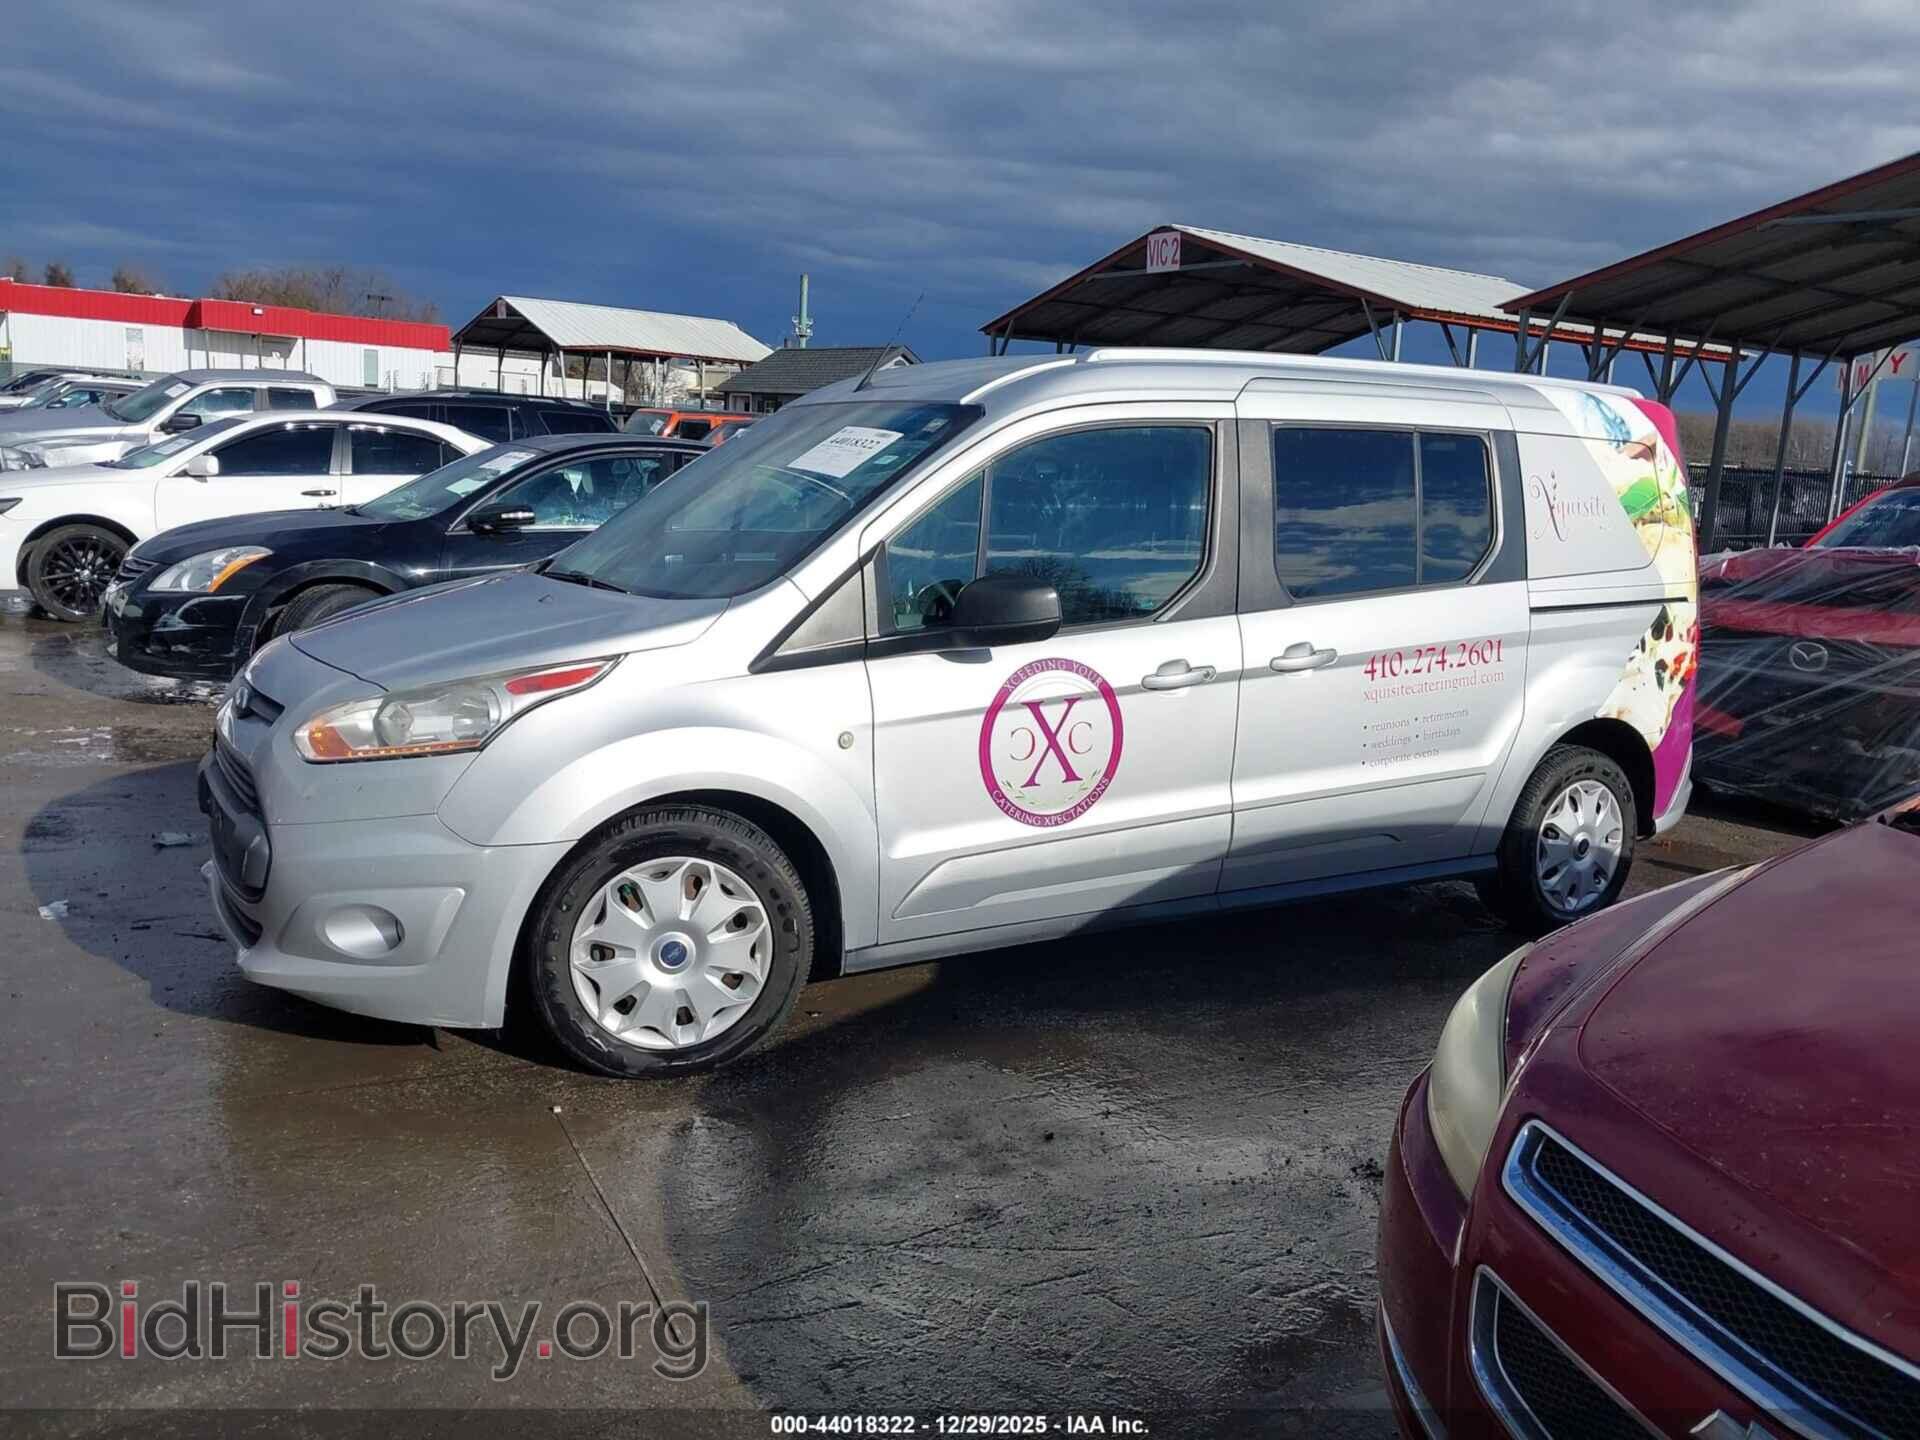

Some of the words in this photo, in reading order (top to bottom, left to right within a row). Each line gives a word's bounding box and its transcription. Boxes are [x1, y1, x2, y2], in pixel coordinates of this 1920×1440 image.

[1148, 237, 1169, 267] VIC
[1171, 237, 1179, 265] 2
[1888, 352, 1909, 374] Y
[1002, 658, 1068, 692] XCEEDING
[1072, 661, 1104, 688] YOUR
[1363, 639, 1504, 682] 410.274.2601
[1363, 670, 1505, 703] xquisitecateringmd.com
[1369, 752, 1412, 768] corporate
[1413, 747, 1440, 760] events
[991, 789, 1042, 826] CATERING
[1043, 776, 1111, 827] XPECTATIONS
